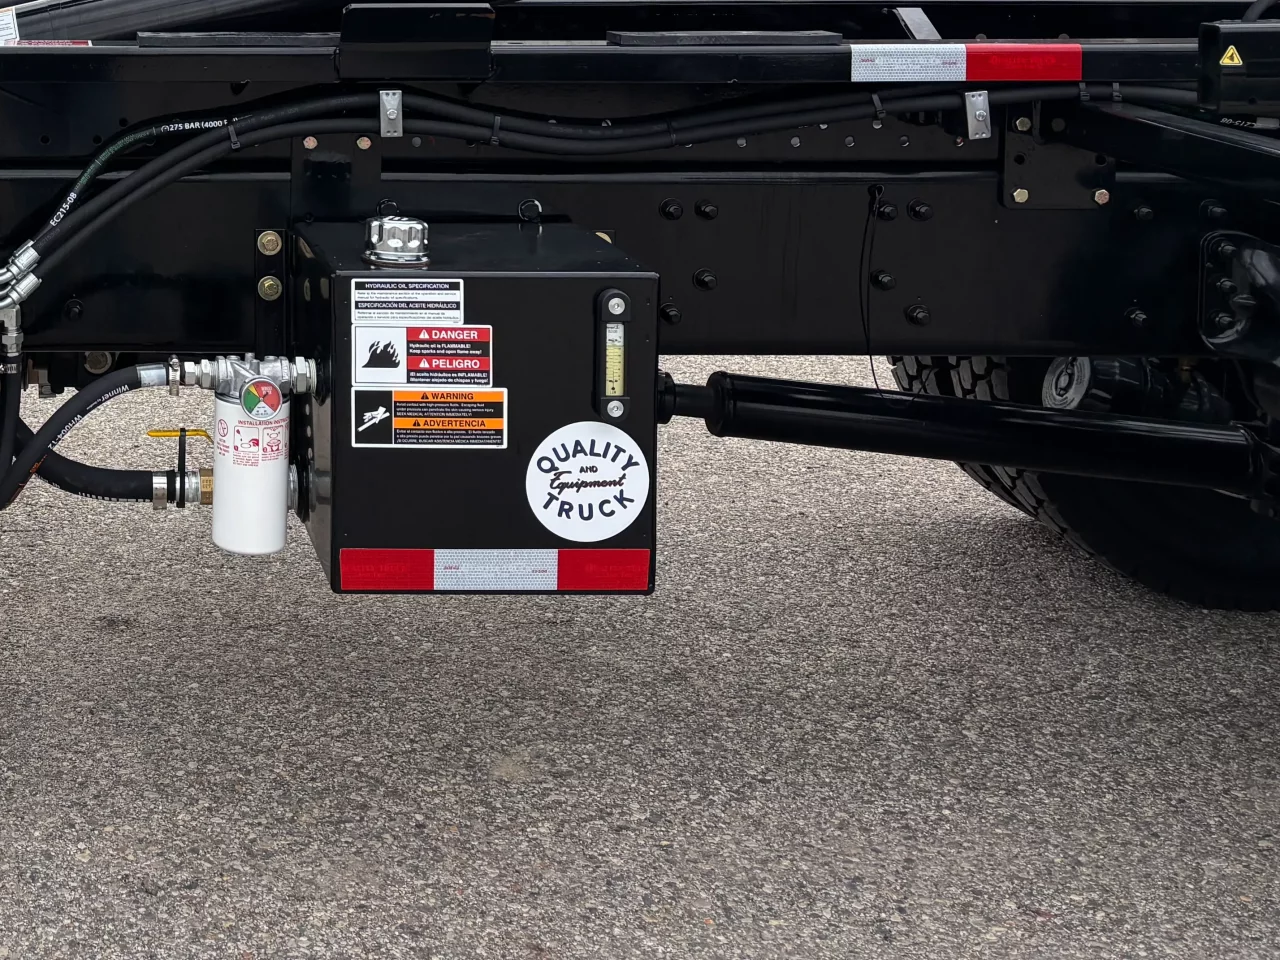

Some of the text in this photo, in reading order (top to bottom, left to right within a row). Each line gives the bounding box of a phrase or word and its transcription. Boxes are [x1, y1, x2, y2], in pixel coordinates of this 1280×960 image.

[169, 120, 223, 131] 275 BAR (4000
[49, 192, 77, 227] EC215-08
[432, 330, 478, 340] DANGER
[432, 359, 480, 368] PELIGRO
[101, 384, 130, 402] Winner
[431, 392, 474, 400] WARNING
[423, 420, 486, 428] ADVERTENCIA
[536, 438, 640, 474] QUALITY
[579, 466, 598, 474] AND
[550, 470, 626, 496] Equipment
[542, 488, 635, 521] TRUCK
